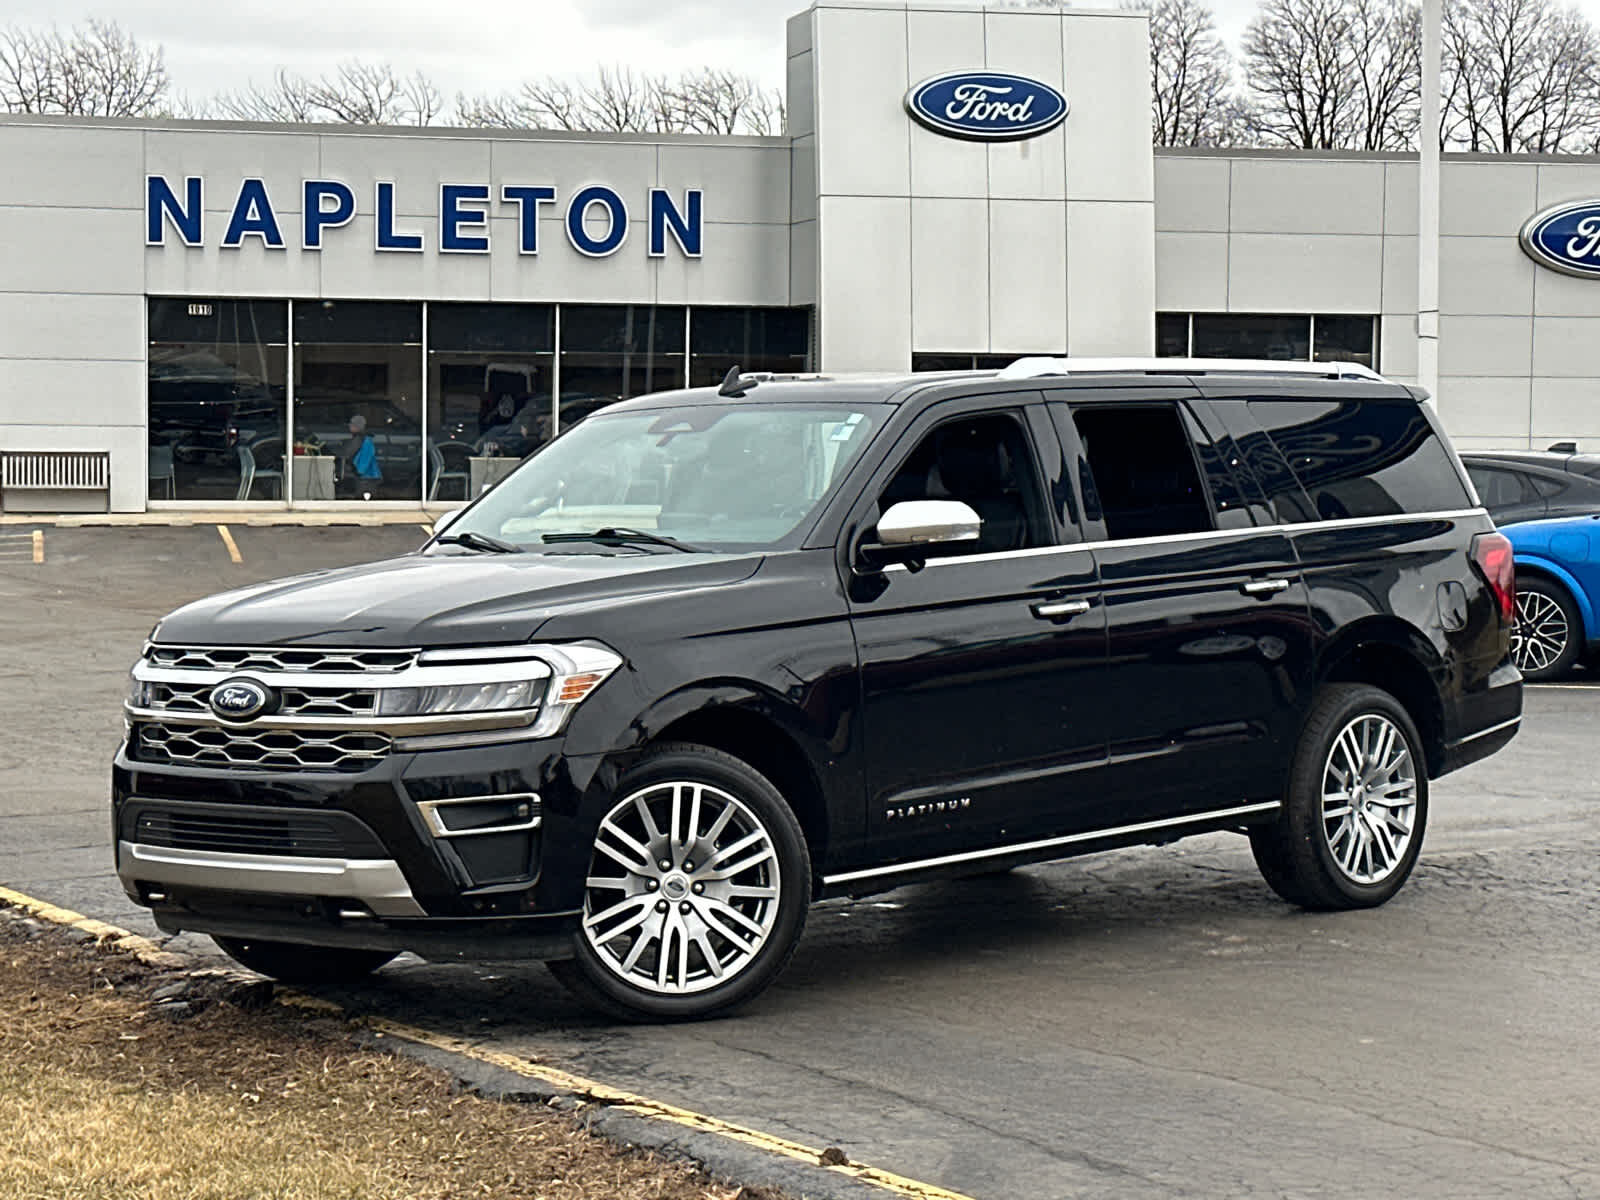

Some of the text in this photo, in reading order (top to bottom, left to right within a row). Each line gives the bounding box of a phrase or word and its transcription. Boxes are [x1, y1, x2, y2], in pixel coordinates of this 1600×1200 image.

[945, 83, 1035, 122] Ford
[145, 175, 703, 258] NAPLETON
[219, 688, 251, 708] Ford
[886, 797, 971, 819] PLATINUM
